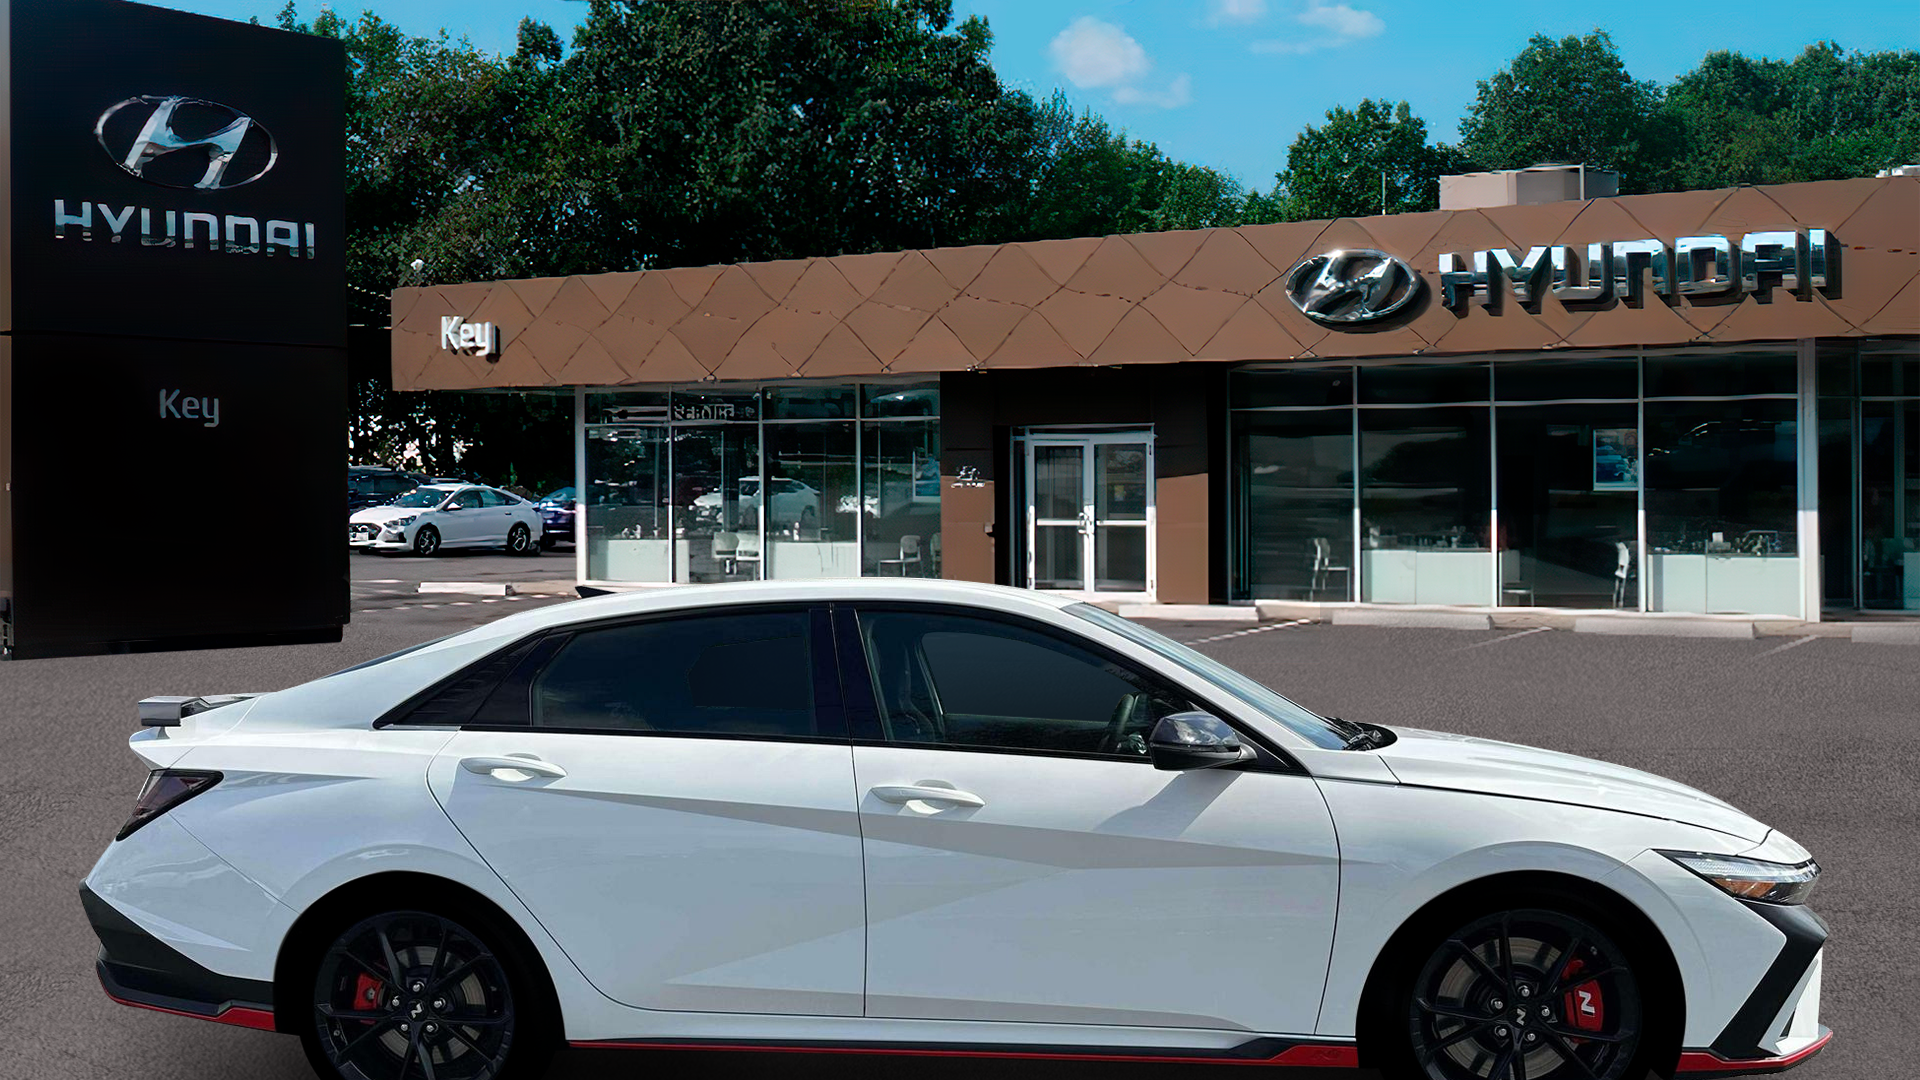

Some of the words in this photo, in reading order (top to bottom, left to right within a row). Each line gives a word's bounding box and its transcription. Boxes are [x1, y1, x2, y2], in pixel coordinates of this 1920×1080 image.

[54, 199, 315, 260] HYUNDAI
[1438, 228, 1840, 314] HYUNDAI
[441, 315, 497, 357] Key
[158, 388, 220, 428] Key
